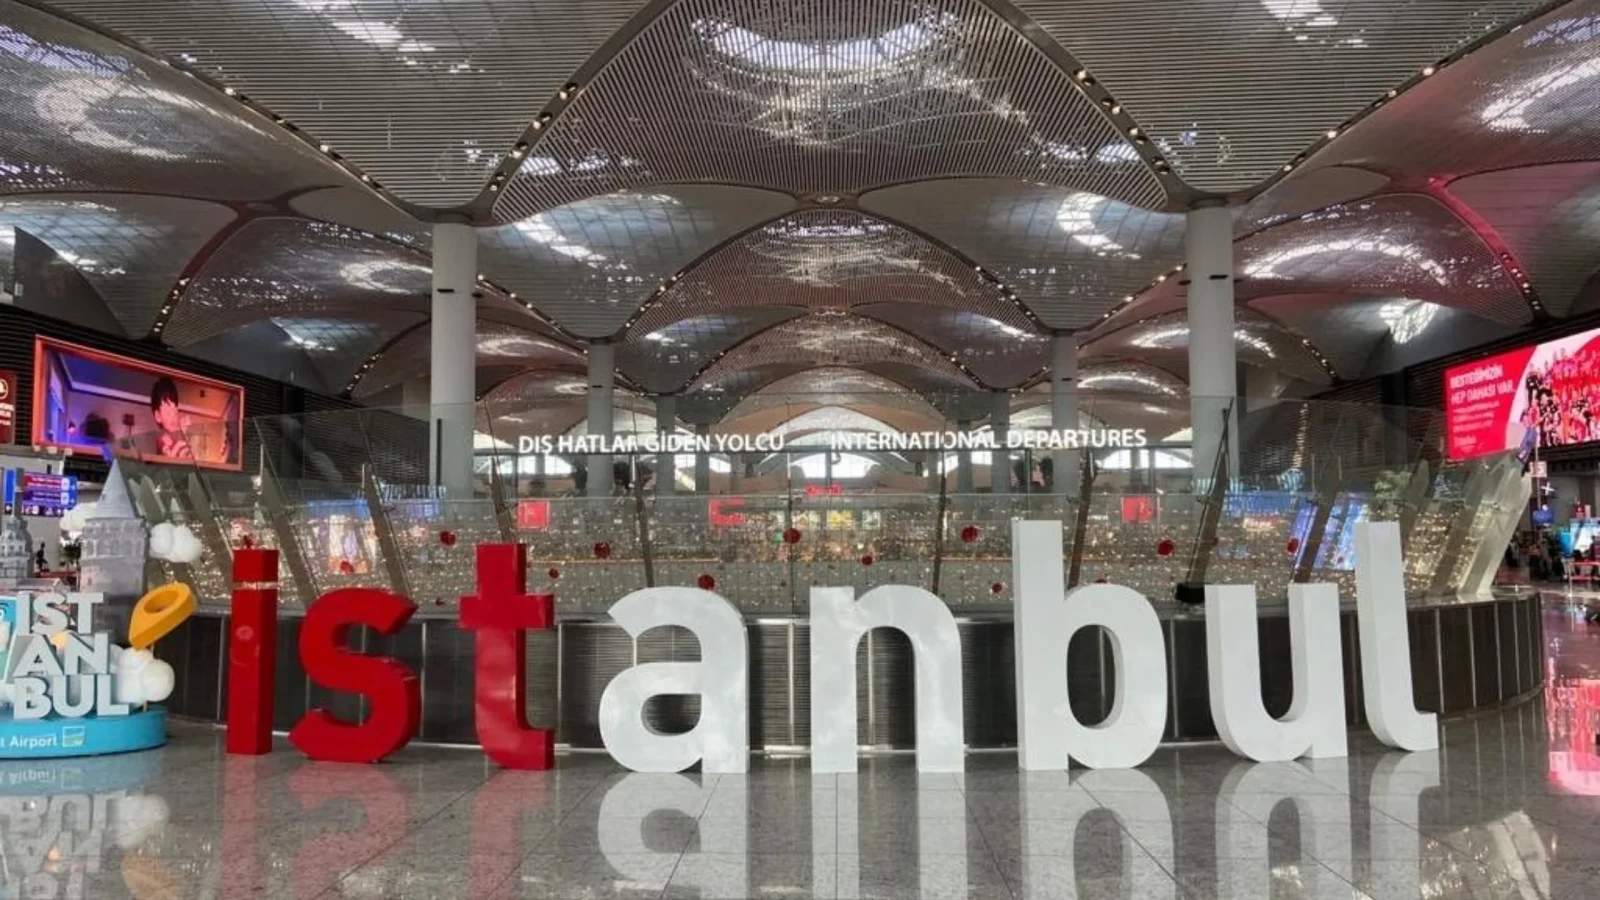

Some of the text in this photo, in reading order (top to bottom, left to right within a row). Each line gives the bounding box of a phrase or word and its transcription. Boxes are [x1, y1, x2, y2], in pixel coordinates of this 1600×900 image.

[518, 434, 553, 457] DIŞ
[644, 430, 710, 453] GİDEN
[715, 433, 784, 452] YOLCU
[830, 428, 1147, 450] INTERNATIONAL DEPARTURES
[12, 632, 109, 676] AN
[14, 674, 130, 720] BUL
[9, 735, 57, 750] Airport
